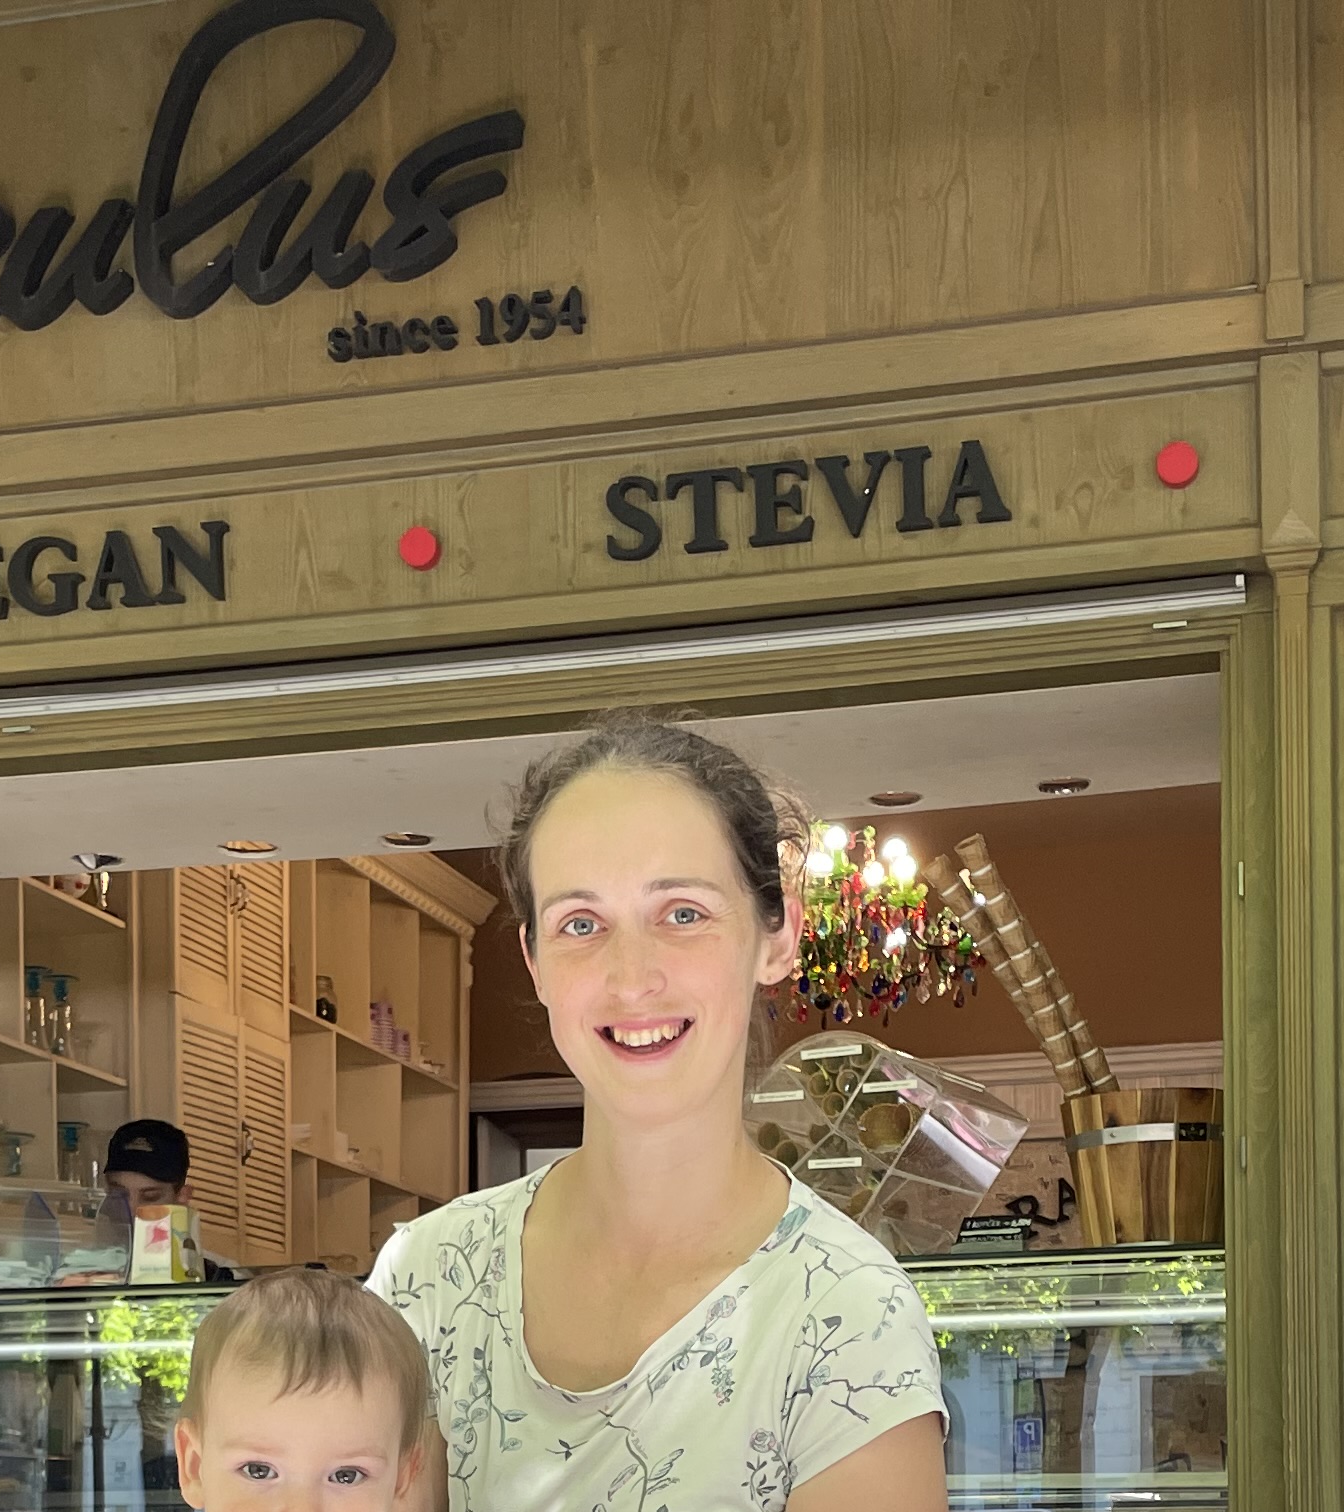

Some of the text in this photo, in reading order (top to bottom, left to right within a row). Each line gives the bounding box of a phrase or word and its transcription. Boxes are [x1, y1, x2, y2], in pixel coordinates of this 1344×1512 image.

[327, 285, 587, 363] since 1954
[606, 440, 1012, 561] STEVIA
